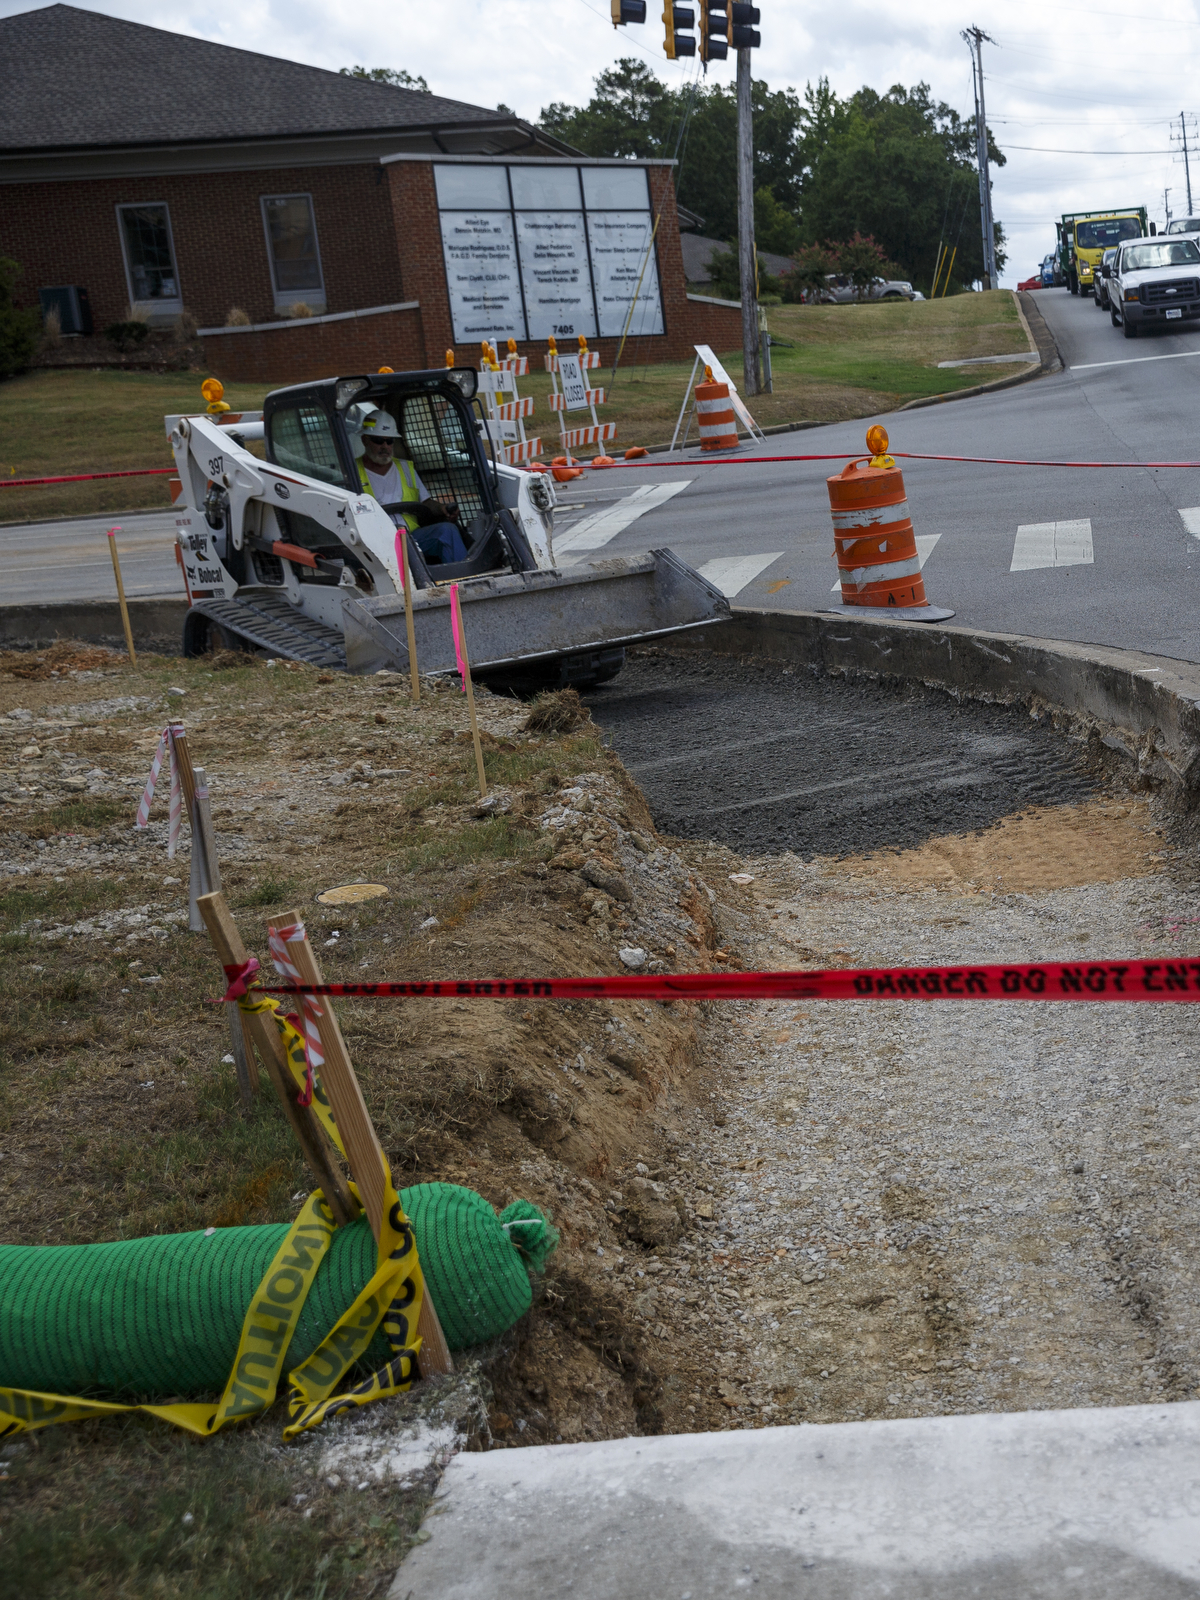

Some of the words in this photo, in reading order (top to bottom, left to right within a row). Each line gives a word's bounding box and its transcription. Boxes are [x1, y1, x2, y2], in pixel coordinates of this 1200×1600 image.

[552, 324, 575, 334] 7405
[562, 363, 578, 379] ROAD
[564, 384, 585, 403] CLOSED
[208, 456, 225, 476] 397
[187, 534, 208, 553] Talley
[198, 567, 224, 584] Bobcat
[853, 970, 988, 995] DANGER
[1000, 967, 1048, 994] DO
[1059, 965, 1130, 993] NOT
